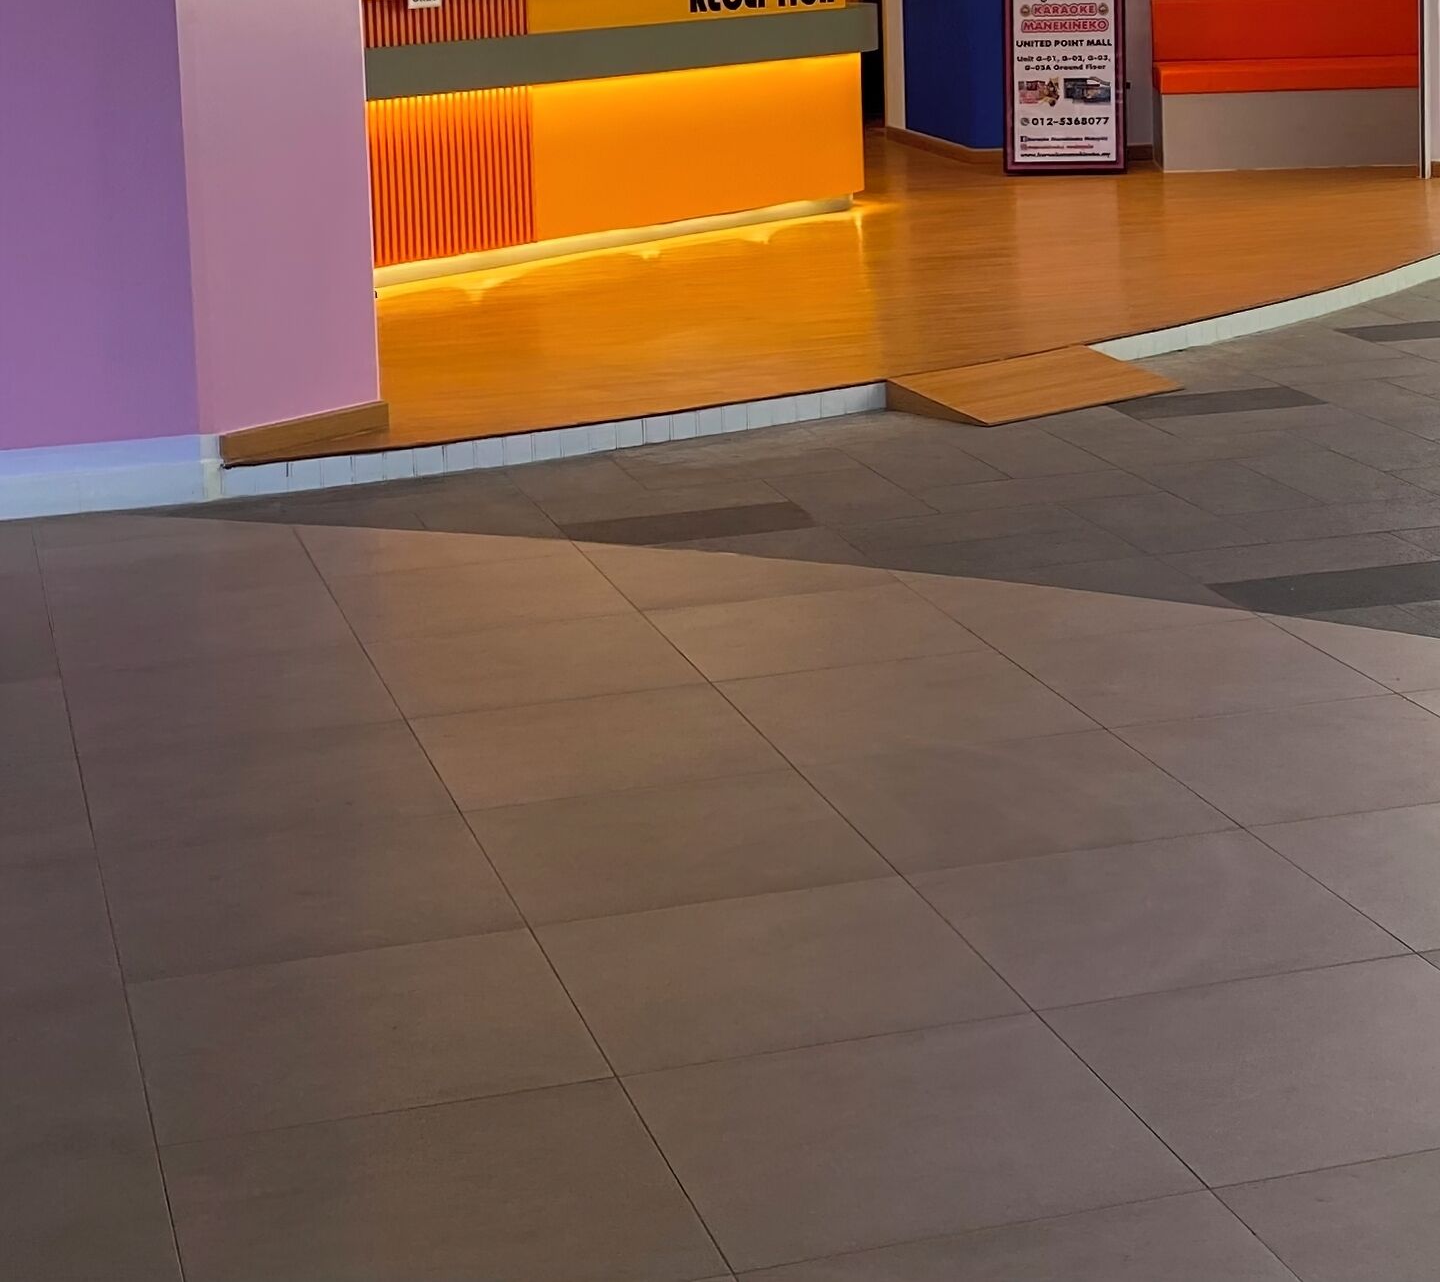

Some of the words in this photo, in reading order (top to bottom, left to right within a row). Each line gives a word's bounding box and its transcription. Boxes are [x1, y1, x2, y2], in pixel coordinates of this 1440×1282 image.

[1032, 4, 1096, 16] KARAOKE
[1022, 20, 1108, 32] MANEKINEKO
[1016, 39, 1051, 48] UNITED
[1054, 39, 1084, 47] POINT
[1086, 38, 1112, 47] MALL
[1031, 117, 1110, 126] 012-5368077
